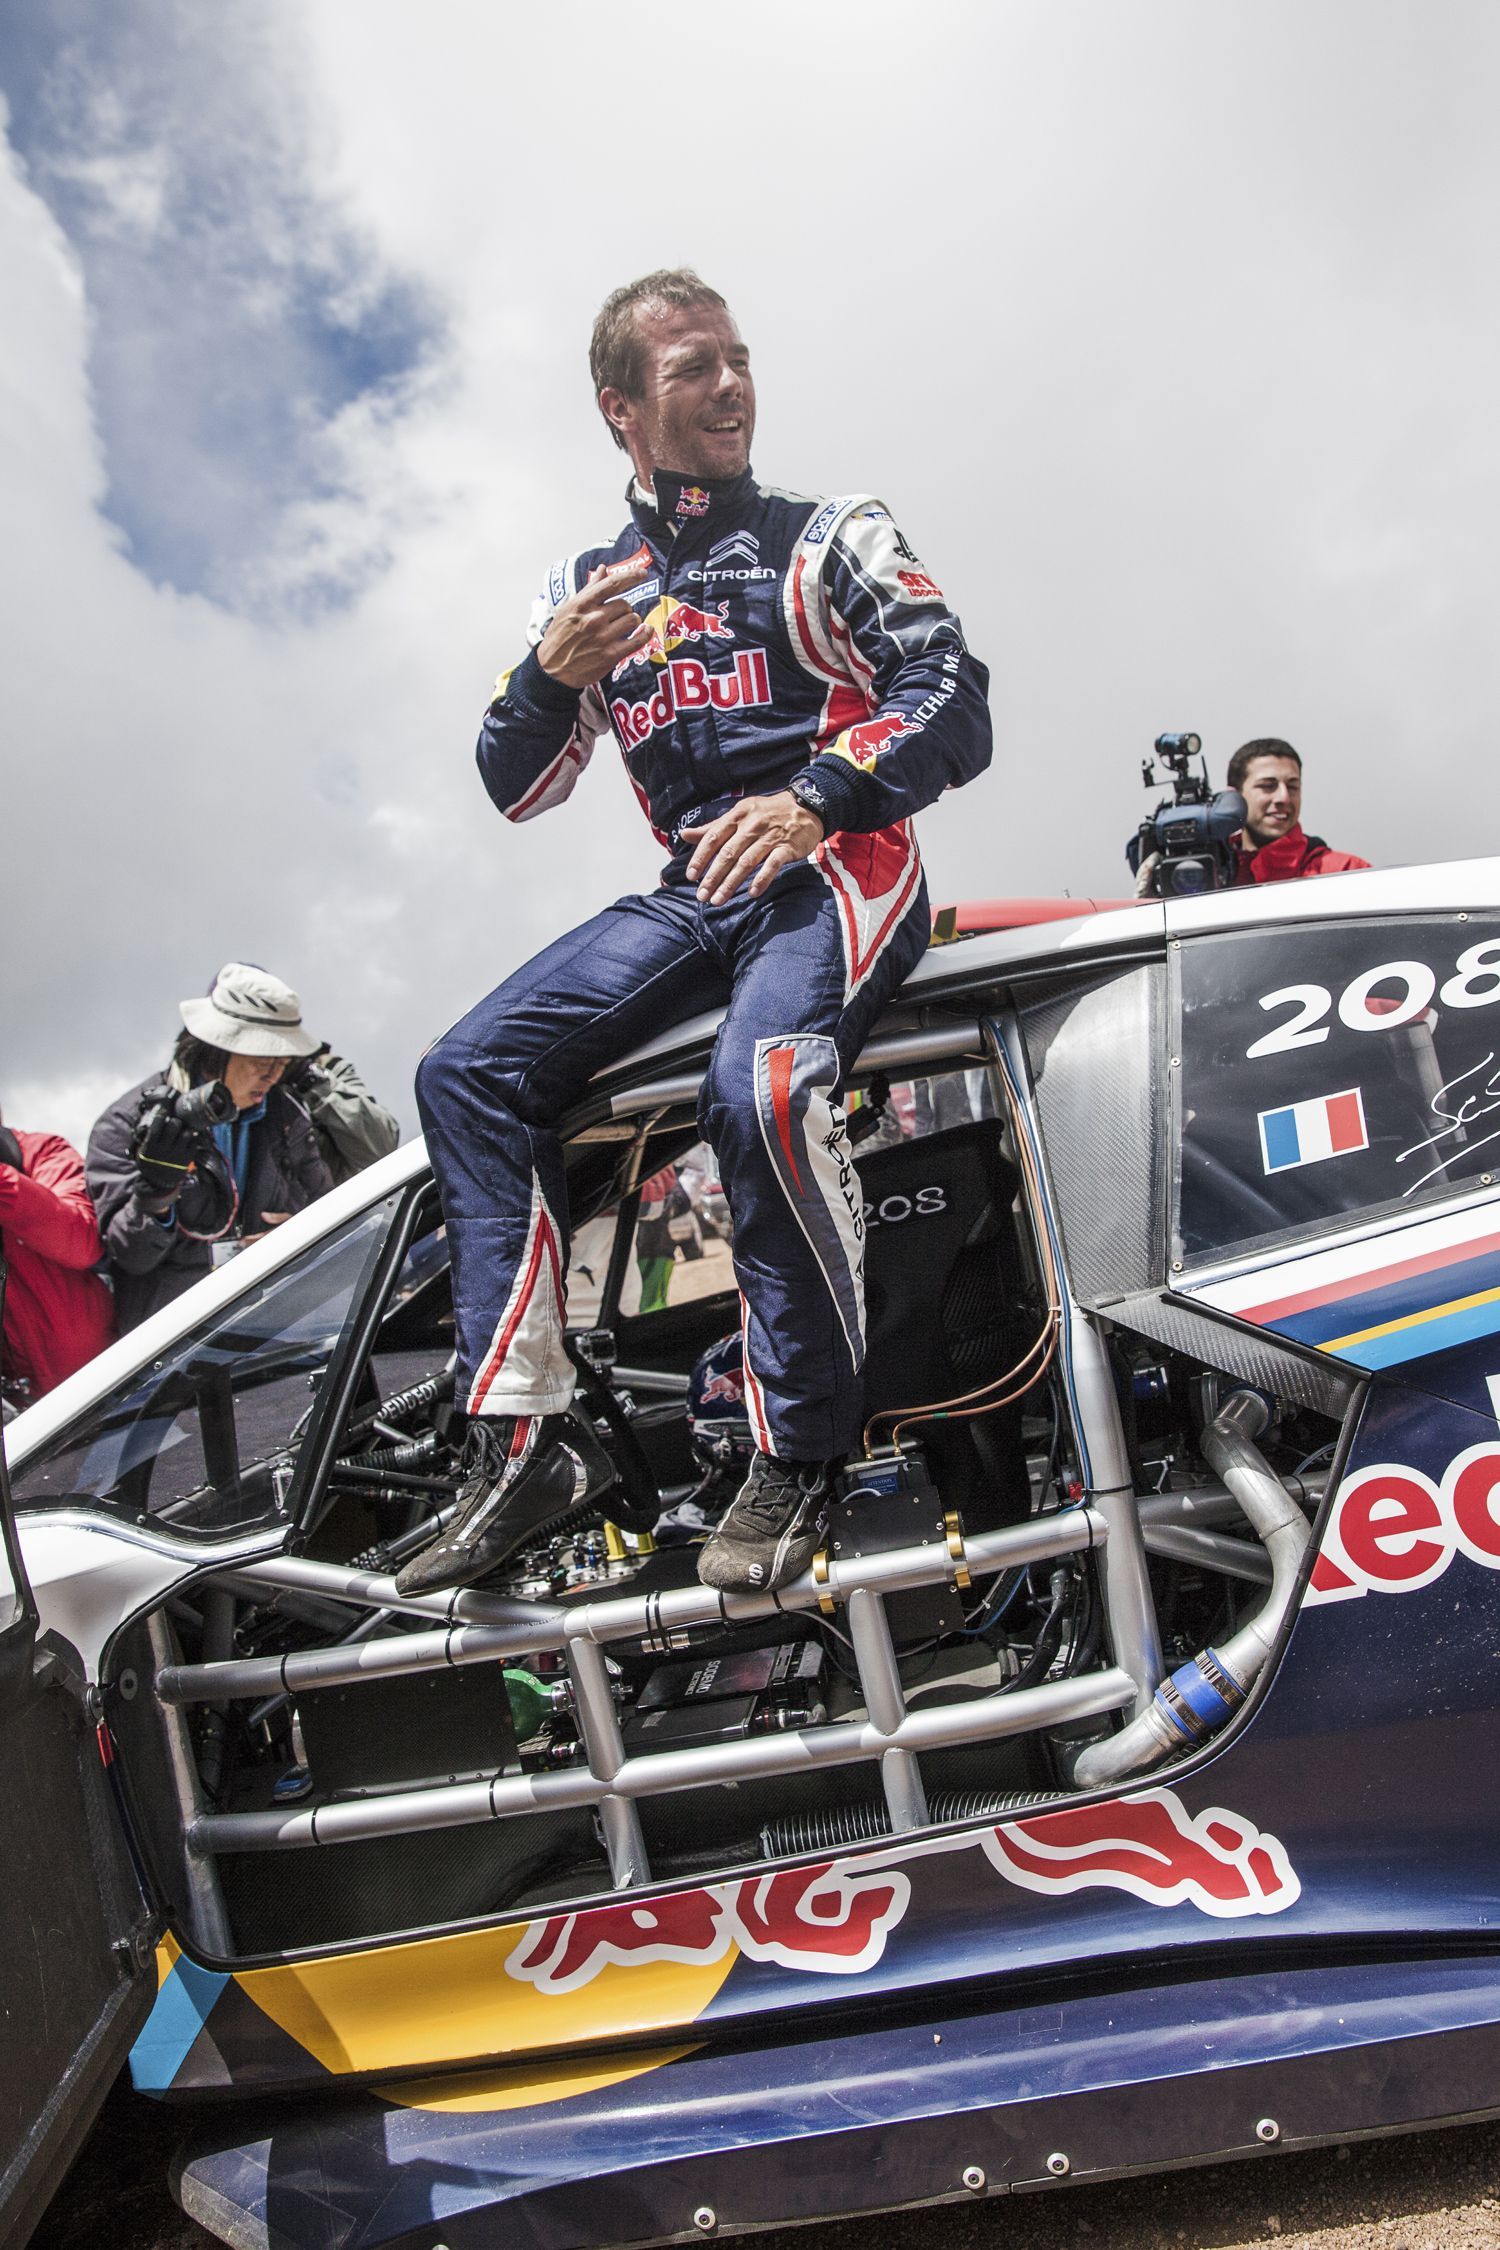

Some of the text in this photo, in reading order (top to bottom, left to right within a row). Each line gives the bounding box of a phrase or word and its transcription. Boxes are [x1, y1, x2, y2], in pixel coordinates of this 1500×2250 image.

[610, 552, 650, 576] TOTAL
[611, 649, 772, 751] Red Bull
[1245, 938, 1500, 1059] 208
